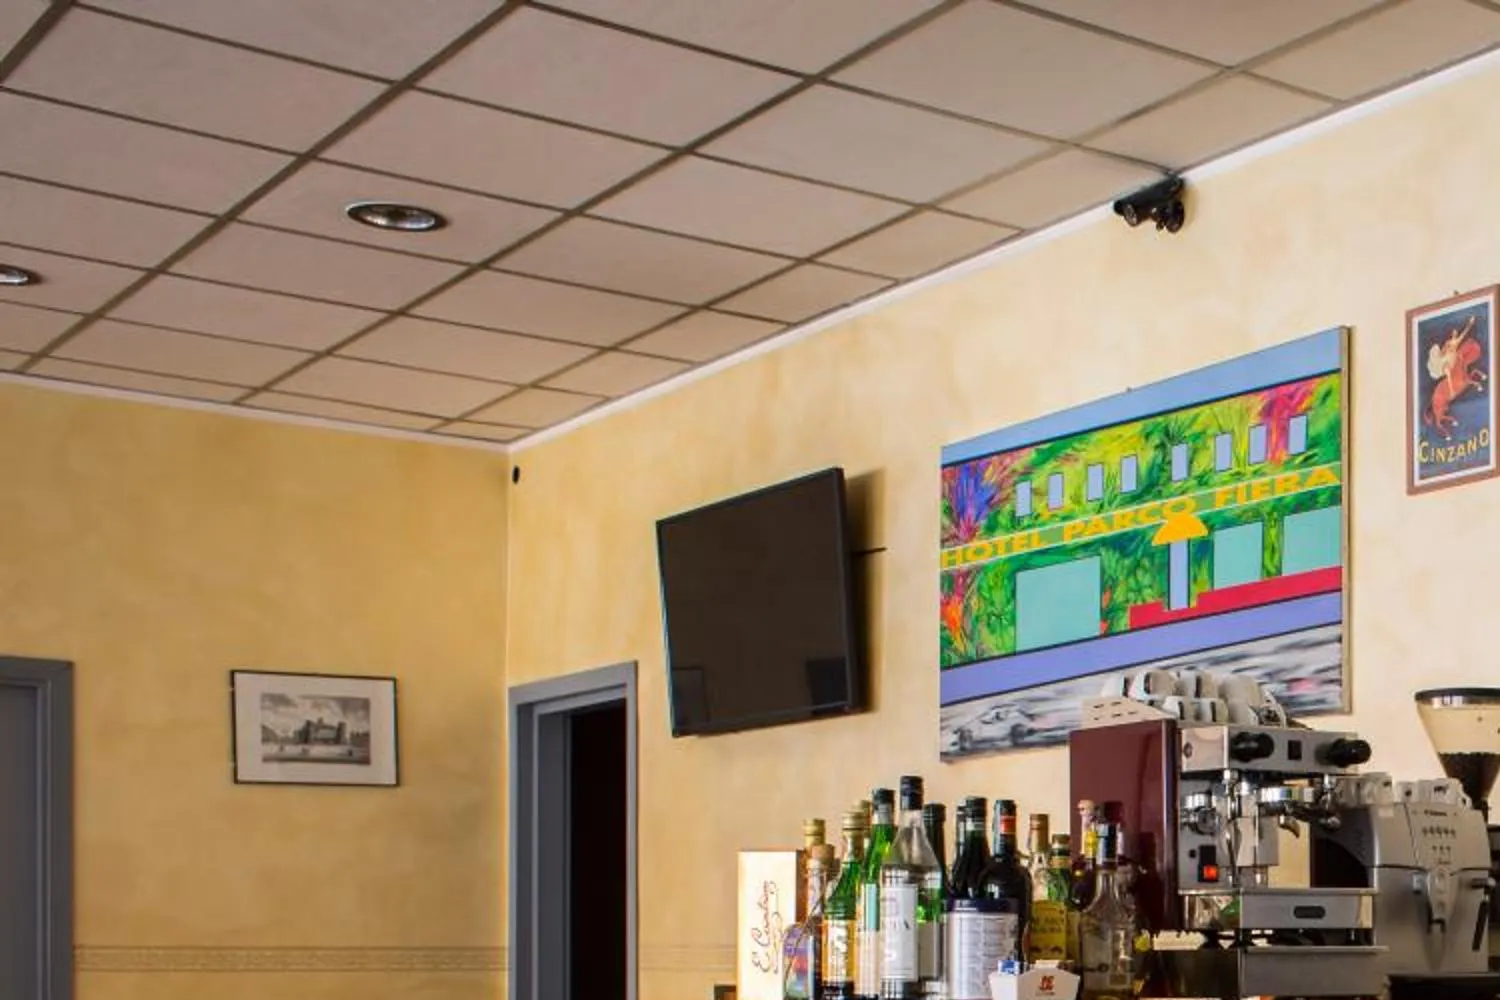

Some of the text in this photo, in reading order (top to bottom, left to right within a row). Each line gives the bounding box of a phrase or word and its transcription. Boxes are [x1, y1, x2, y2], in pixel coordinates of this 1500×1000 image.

[1418, 428, 1490, 463] CINZANO
[941, 466, 1339, 569] HOTEL PARCO FIERA
